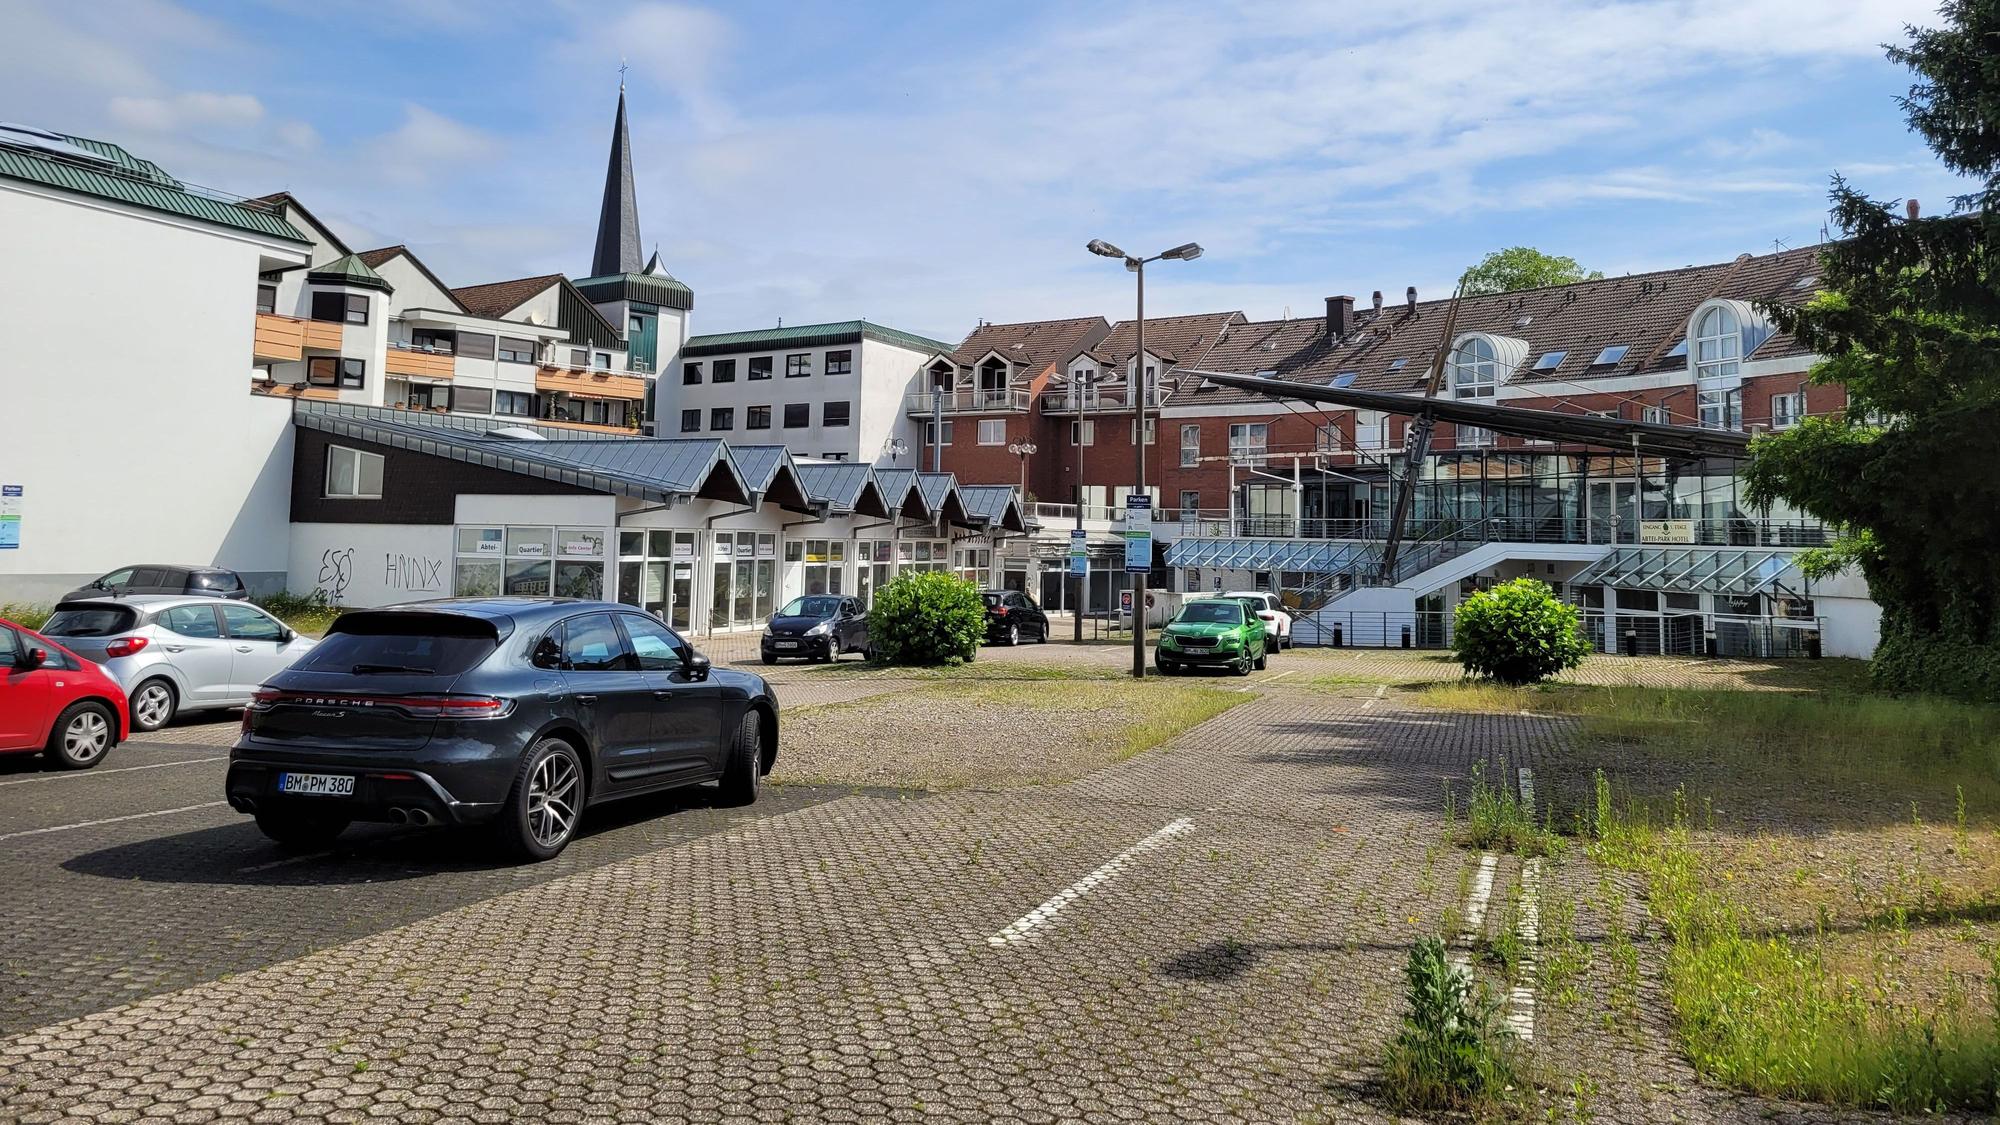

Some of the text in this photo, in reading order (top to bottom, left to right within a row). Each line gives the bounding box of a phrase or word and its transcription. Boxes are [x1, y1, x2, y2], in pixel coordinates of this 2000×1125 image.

[480, 543, 499, 551] Abtei-
[518, 546, 543, 554] Quartier
[295, 698, 374, 707] PORSCHE
[285, 775, 354, 793] BM PM 380
